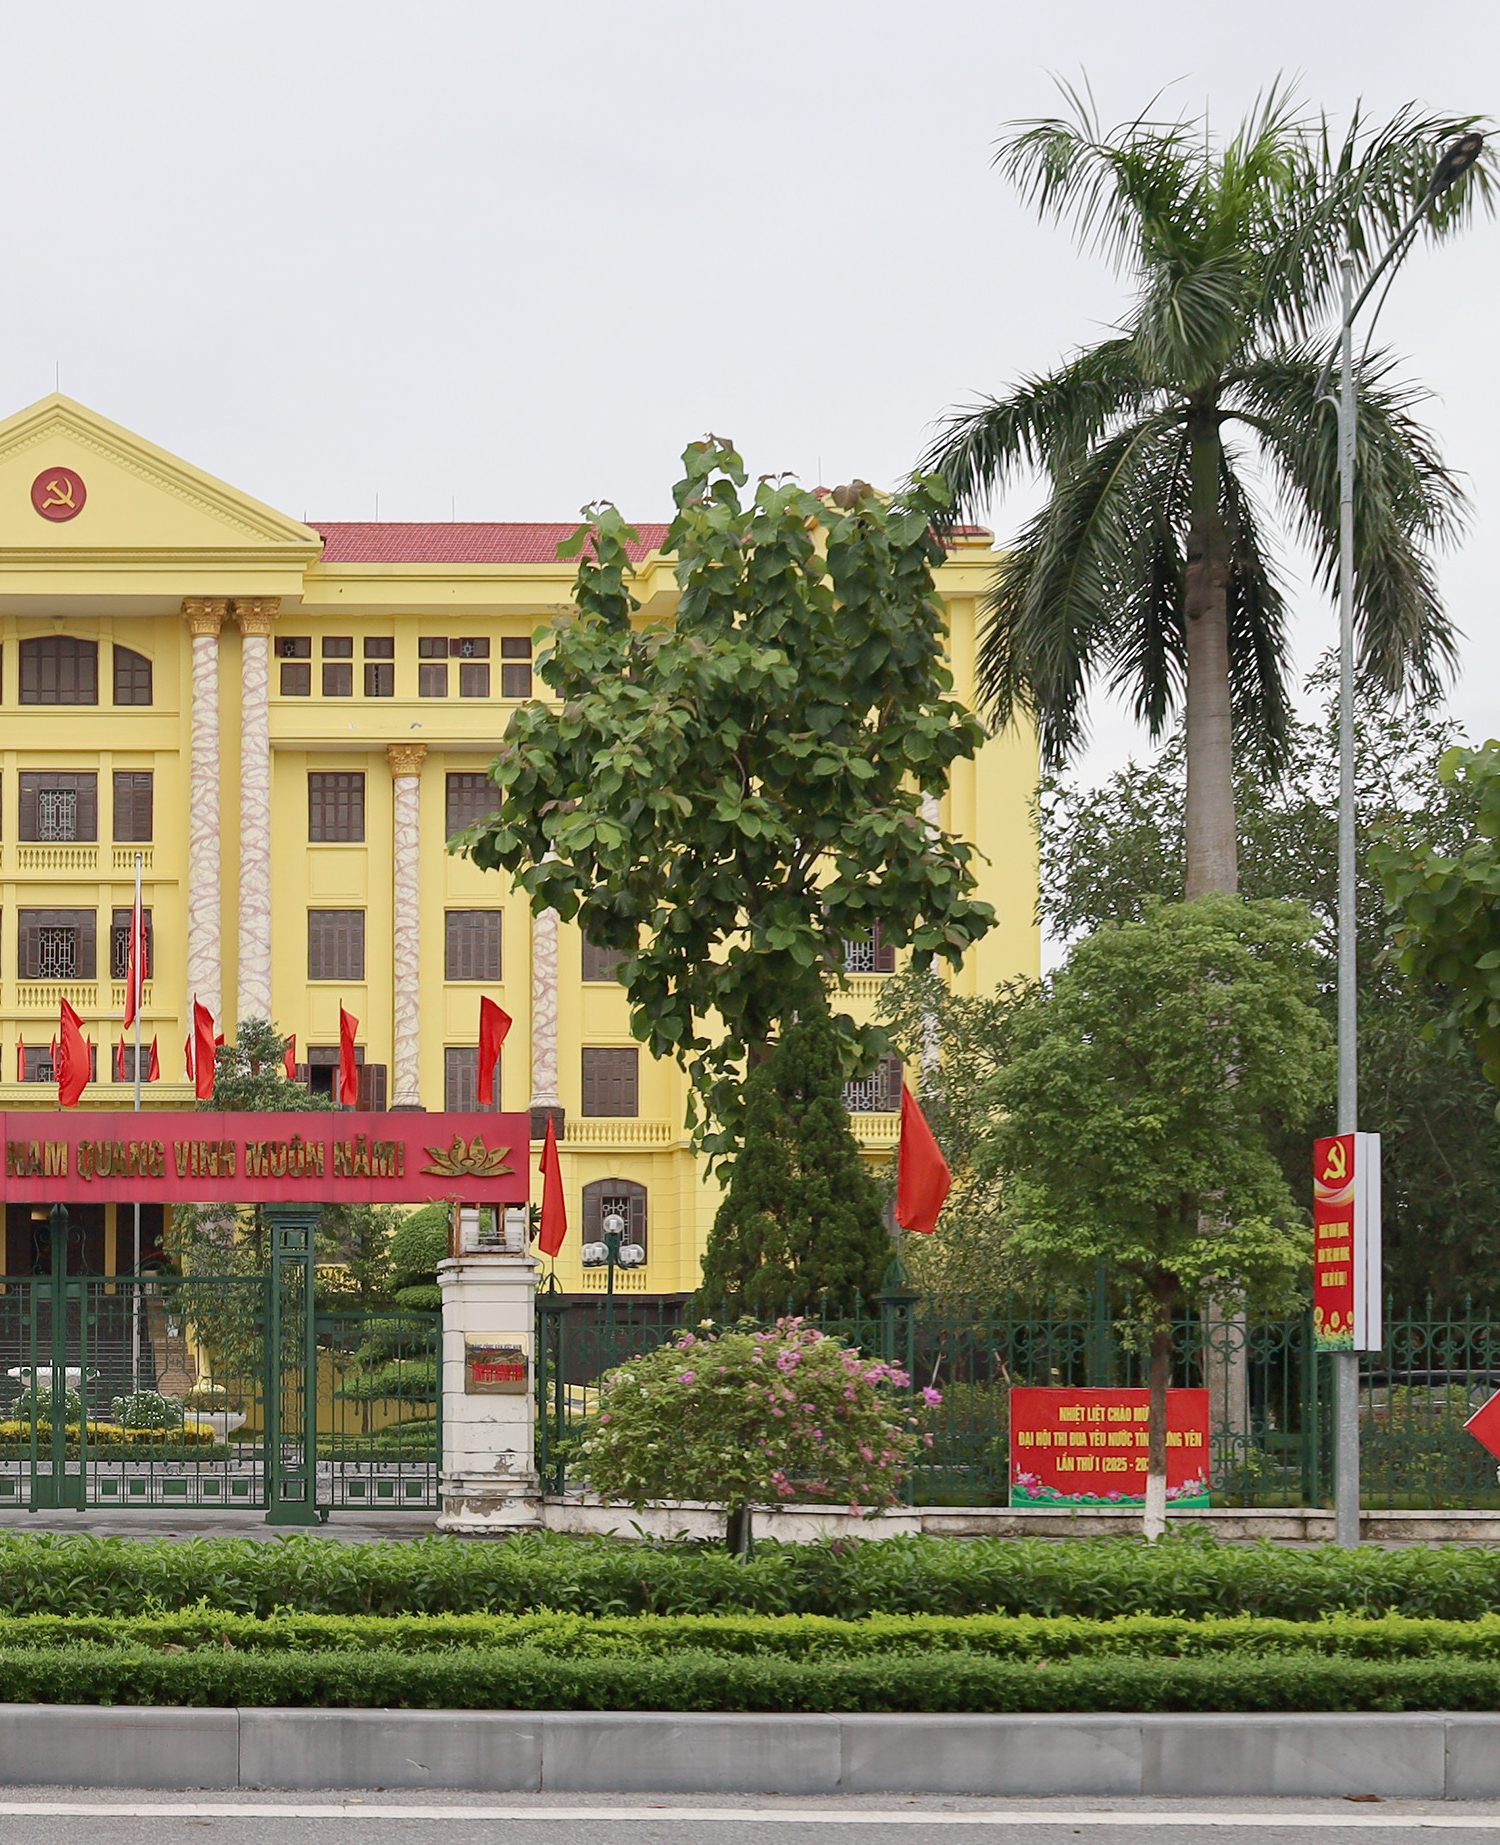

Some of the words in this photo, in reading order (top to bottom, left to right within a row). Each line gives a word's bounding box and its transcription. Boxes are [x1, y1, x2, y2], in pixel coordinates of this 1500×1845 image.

[6, 1140, 68, 1176] NAM
[76, 1139, 165, 1181] QUANG
[173, 1140, 236, 1176] VINH
[245, 1132, 324, 1177] MUÔN
[332, 1132, 405, 1177] NĂM!
[1059, 1404, 1086, 1424] NHIỆT
[1087, 1404, 1106, 1424] LIỆT
[1107, 1404, 1132, 1421] CHÀO
[1133, 1404, 1150, 1421] MỪ
[1018, 1431, 1034, 1450] ĐẠI
[1035, 1428, 1051, 1450] HỘI
[1053, 1431, 1068, 1446] THI
[1069, 1431, 1088, 1446] ĐUA
[1089, 1428, 1106, 1446] YÊU
[1135, 1427, 1150, 1446] TỈN
[1165, 1430, 1183, 1446] ƯNG
[1184, 1429, 1203, 1446] YÊN
[1076, 1453, 1095, 1472] THỨ
[1095, 1457, 1100, 1471] I
[1102, 1457, 1128, 1473] (2025
